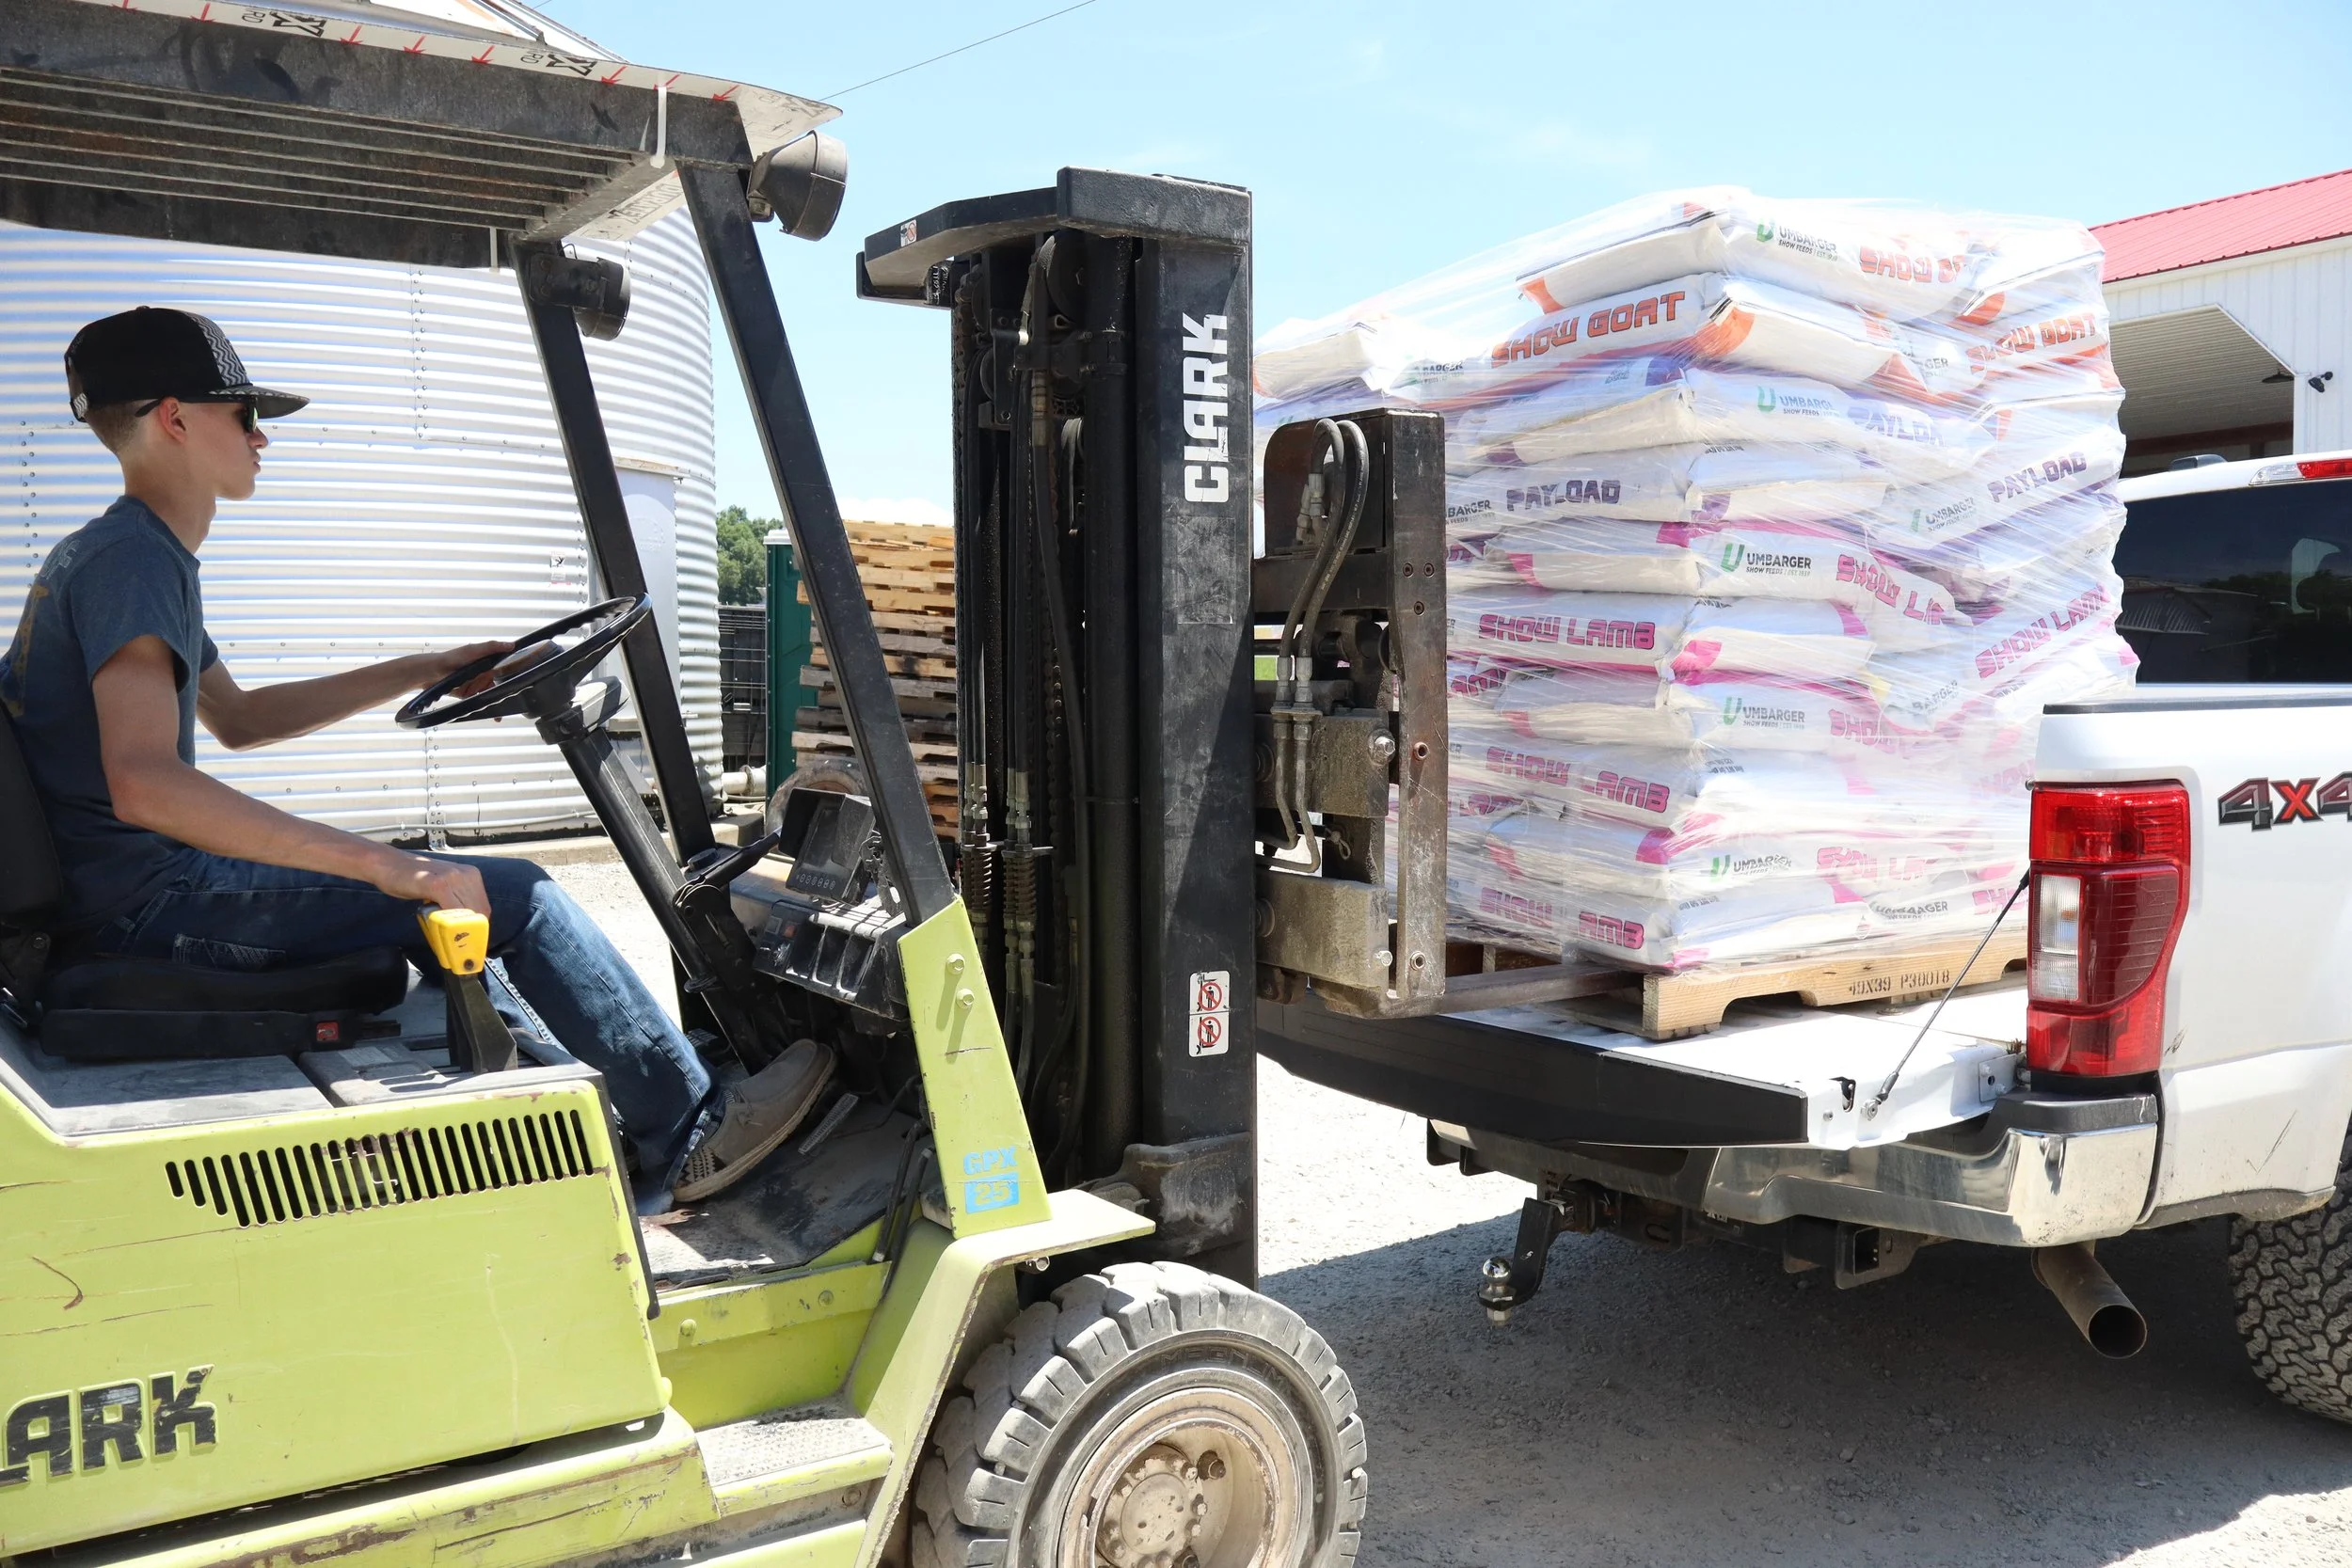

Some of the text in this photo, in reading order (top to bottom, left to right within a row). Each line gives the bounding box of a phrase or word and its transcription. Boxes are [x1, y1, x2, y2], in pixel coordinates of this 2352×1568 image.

[1778, 226, 1838, 254] UMBARGER
[1778, 239, 1796, 249] SHOW
[1795, 245, 1814, 255] FEEDS
[1491, 290, 1686, 369] SHOW GOAT
[2038, 311, 2097, 348] GOAT
[1182, 312, 1230, 503] CLARK
[1779, 396, 1835, 410] UMBARG
[1783, 407, 1802, 416] SHOW
[1987, 451, 2089, 503] PAYLOAD
[1447, 480, 1621, 518] BARGER PAYLOAD
[1746, 552, 1812, 570] UMBARGER
[1478, 613, 1560, 644] SHOW
[1566, 618, 1656, 650] LAMB
[1975, 617, 2052, 679] SHOW
[1742, 706, 1805, 723] UMBARGER
[1486, 746, 1571, 786] SHOW
[1479, 886, 1552, 929] SHOW
[1577, 911, 1645, 950] AMB
[1900, 969, 1950, 990] P30018
[963, 1146, 1018, 1175] GPX
[974, 1181, 1011, 1205] 25
[0, 1365, 218, 1487] ARK
